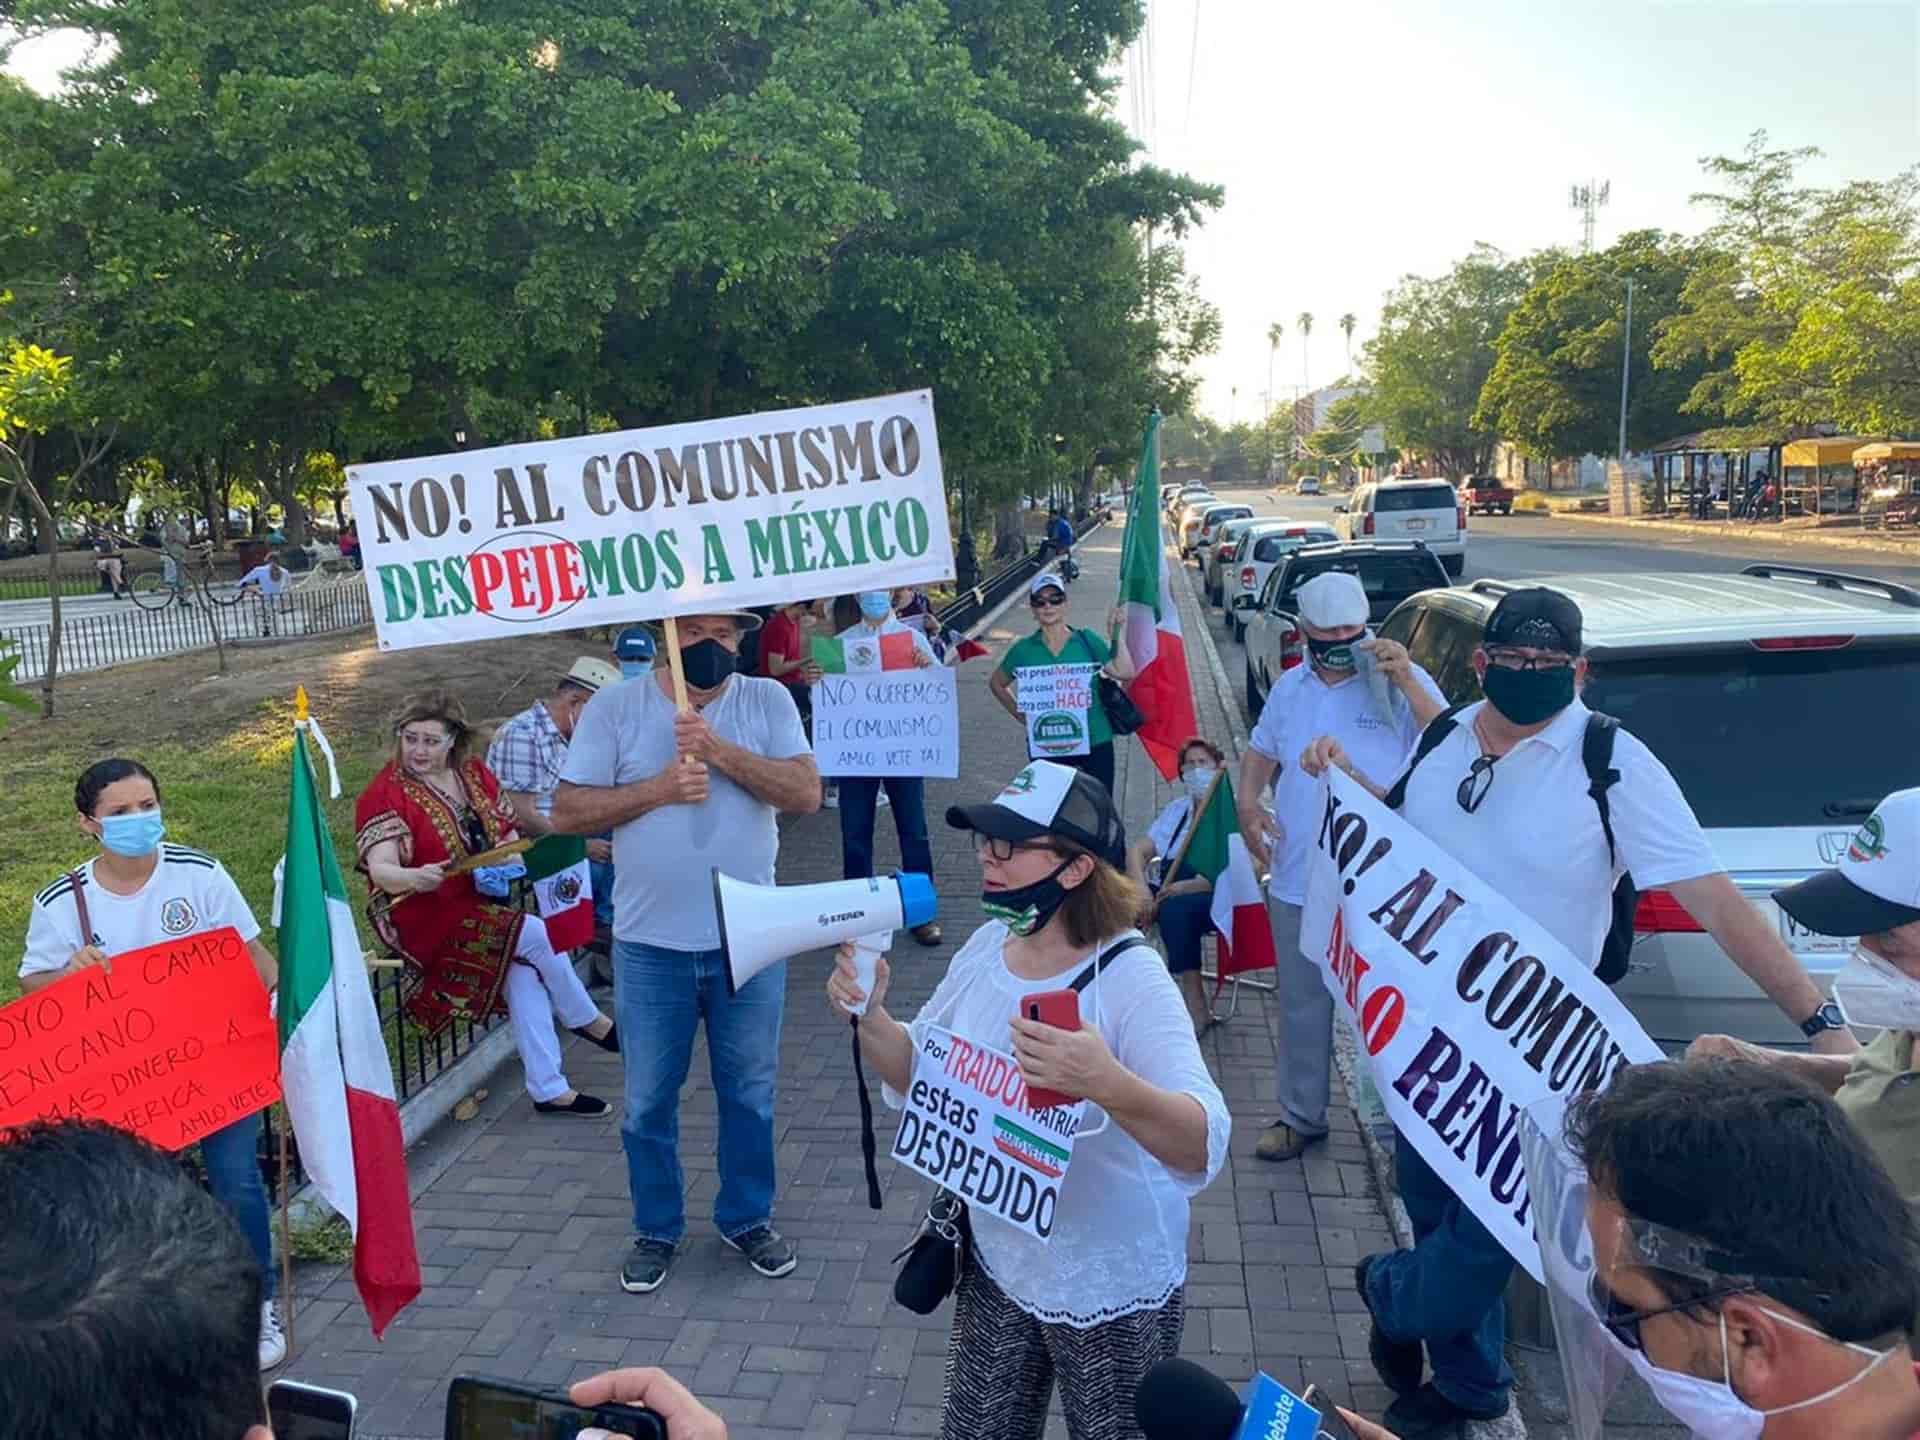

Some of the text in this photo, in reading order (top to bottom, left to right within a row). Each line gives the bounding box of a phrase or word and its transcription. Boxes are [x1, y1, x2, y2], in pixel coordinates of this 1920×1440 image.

[367, 414, 922, 544] NO! AL COMUNISMO
[376, 496, 931, 625] DESPEJEMOS A MÉXICO
[820, 680, 951, 707] NO QUEREMOS
[843, 714, 943, 740] COMUNISMO
[1318, 784, 1392, 896] NO!
[1368, 867, 1465, 965] AL
[85, 975, 129, 1011] AL
[143, 936, 242, 985] CAMPO
[111, 1035, 203, 1097] DINERO
[226, 1018, 243, 1044] A
[924, 1039, 948, 1061] Por
[228, 1081, 269, 1111] VETE
[911, 1079, 979, 1135] estas
[1032, 1106, 1080, 1138] PATRIA
[894, 1110, 1057, 1238] DESPEDIDO
